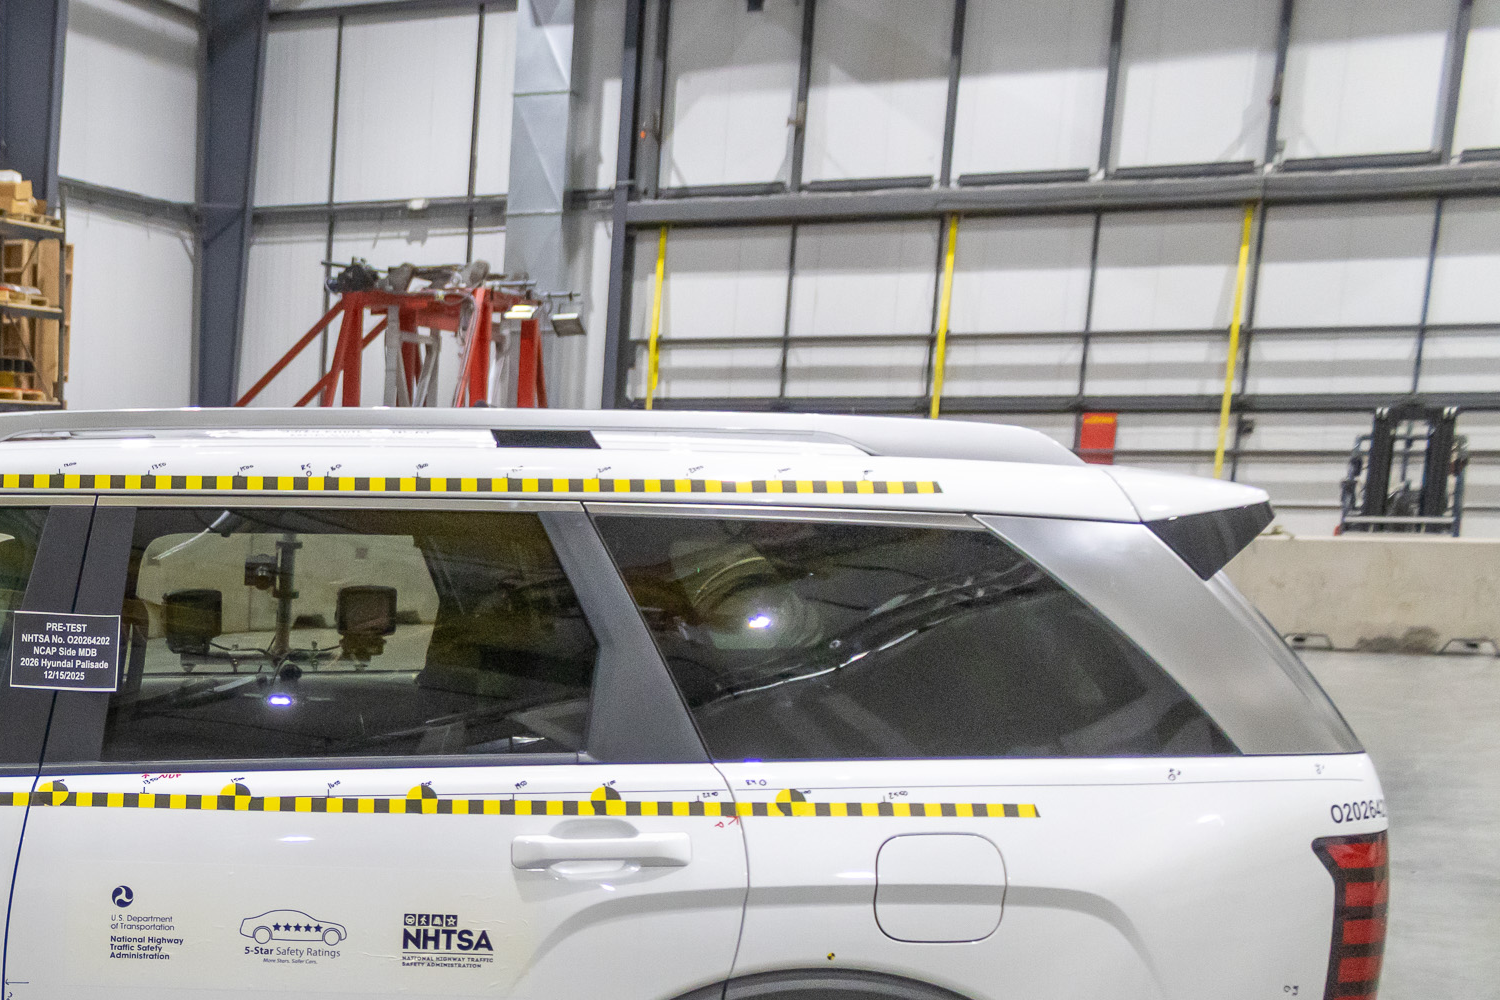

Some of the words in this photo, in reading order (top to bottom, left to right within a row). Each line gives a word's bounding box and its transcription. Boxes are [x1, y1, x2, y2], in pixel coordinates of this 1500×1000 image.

[46, 622, 87, 633] PRE-TEST
[21, 633, 50, 643] NHTSA
[51, 635, 66, 644] No.
[33, 646, 57, 655] NCAP
[58, 647, 77, 656] Side
[78, 648, 97, 657] MDB
[20, 658, 39, 667] 2026
[41, 658, 74, 669] Hyundai
[75, 660, 109, 669] Palisade
[43, 670, 85, 680] 12/15/2025
[111, 914, 125, 922] U.S.
[126, 914, 173, 923] Department
[110, 922, 119, 930] of
[120, 922, 175, 932] Transportation
[110, 935, 146, 943] National
[147, 936, 184, 946] Highway
[402, 927, 494, 952] NHTSA
[110, 943, 135, 951] Traffic
[137, 944, 163, 953] Safety
[244, 946, 274, 955] 5-Star
[276, 946, 305, 958] Safety
[306, 947, 341, 960] Ratings
[109, 951, 170, 960] Administration
